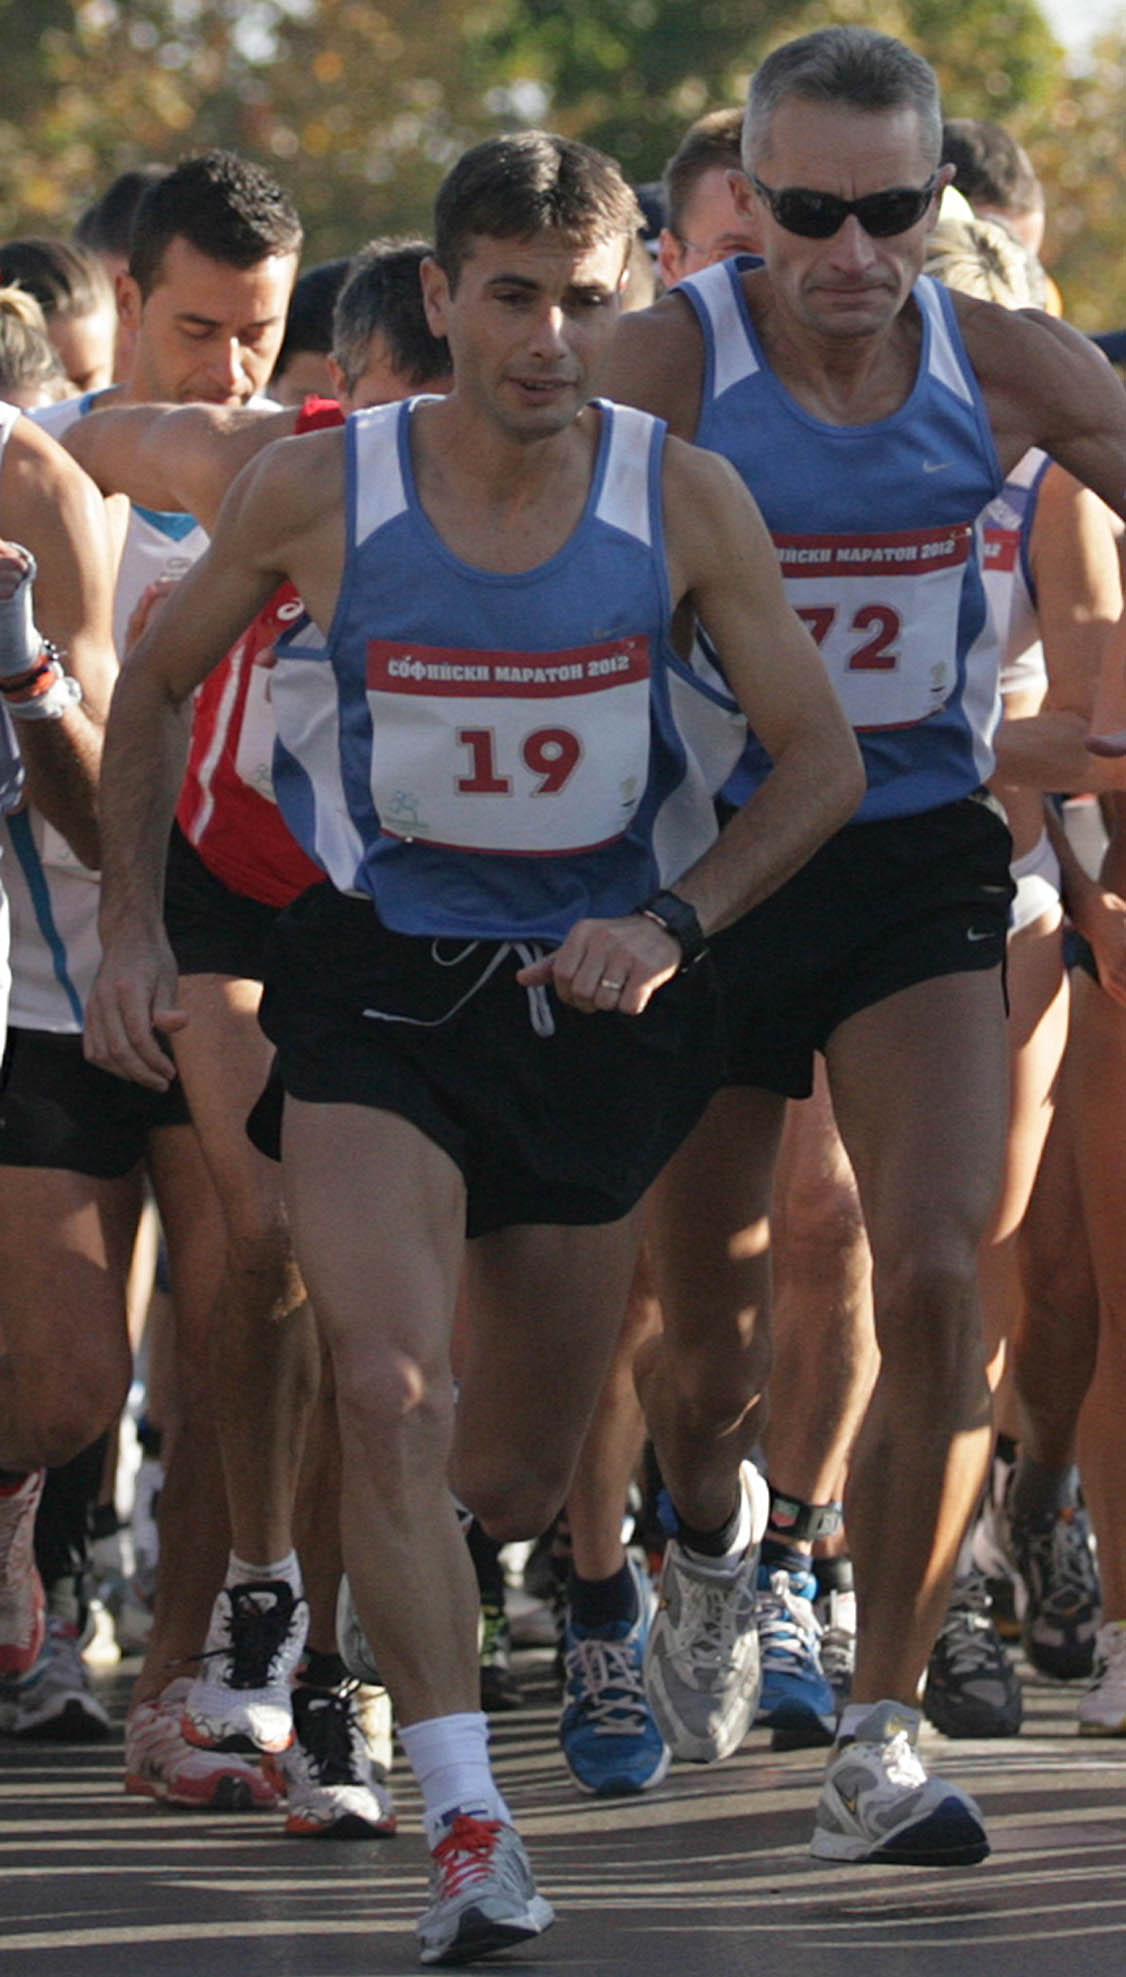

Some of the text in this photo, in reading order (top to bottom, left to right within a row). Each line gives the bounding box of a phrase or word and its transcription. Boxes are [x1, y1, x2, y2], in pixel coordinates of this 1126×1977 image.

[836, 546, 918, 562] МАРАТОН
[920, 540, 956, 559] 2012
[794, 604, 901, 670] 72
[387, 655, 630, 683] СОФИЙСКИ МАРАТОН 2012
[456, 727, 583, 796] 19
